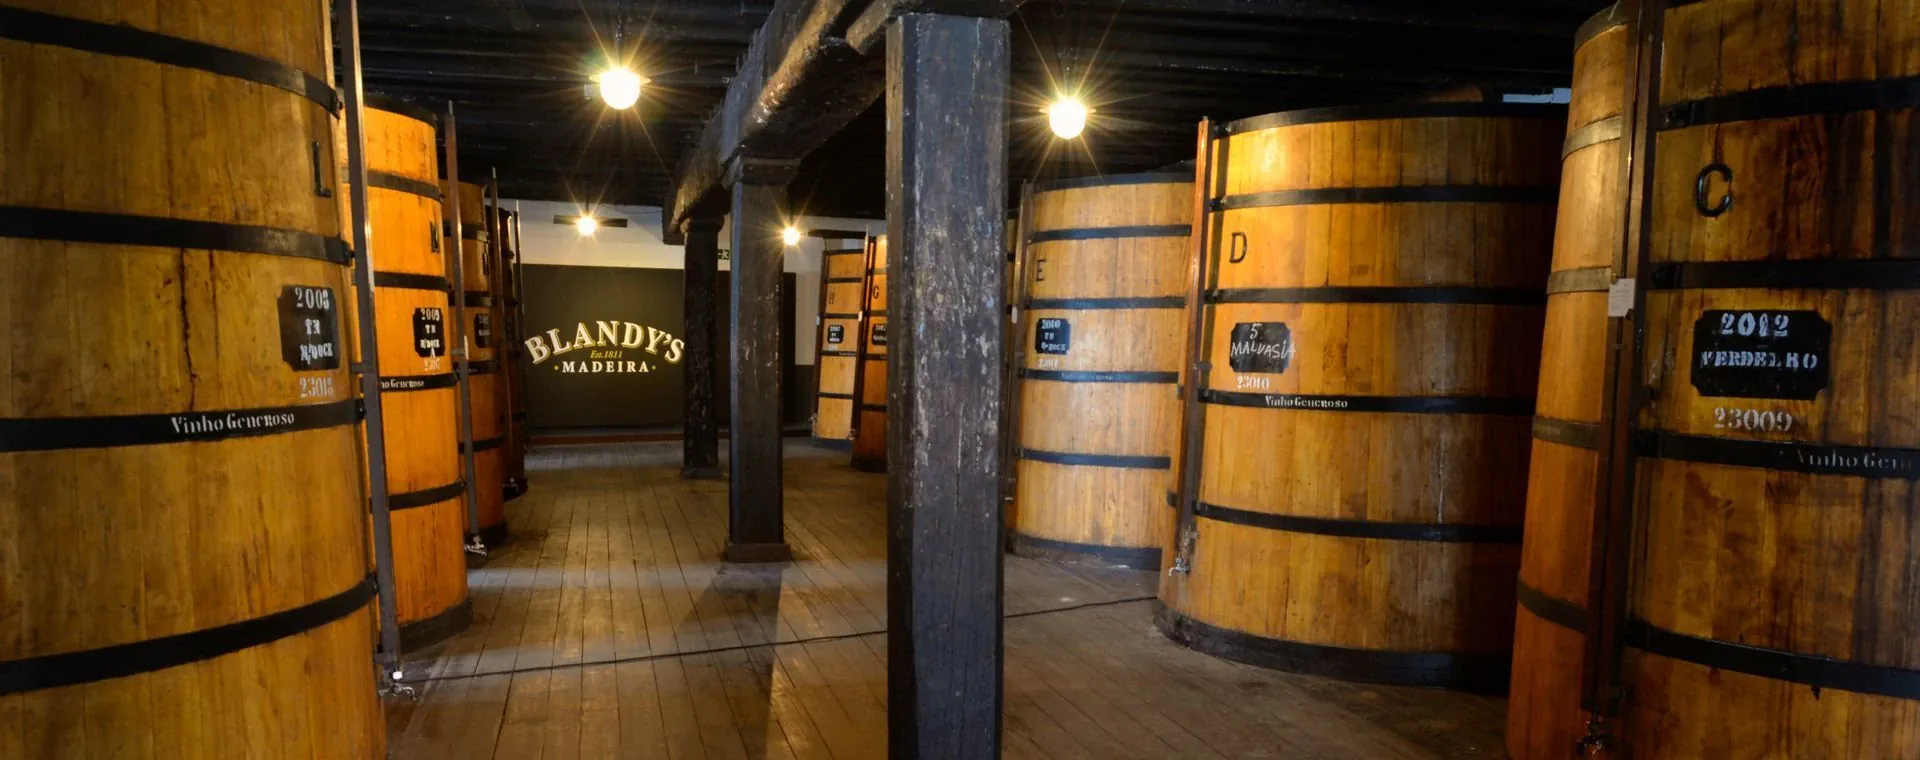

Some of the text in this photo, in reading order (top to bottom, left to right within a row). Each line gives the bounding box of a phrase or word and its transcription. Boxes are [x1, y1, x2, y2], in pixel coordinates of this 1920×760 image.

[312, 140, 332, 198] L
[1696, 163, 1732, 217] C
[1229, 231, 1247, 263] D
[1036, 259, 1047, 282] E
[1721, 312, 1789, 337] 2012
[524, 320, 685, 364] BLANDY'S
[561, 360, 649, 373] MADEIRA
[1236, 375, 1270, 389] 23010
[1265, 394, 1293, 407] Vinho
[171, 412, 223, 435] Vinho
[1714, 407, 1793, 431] 23009
